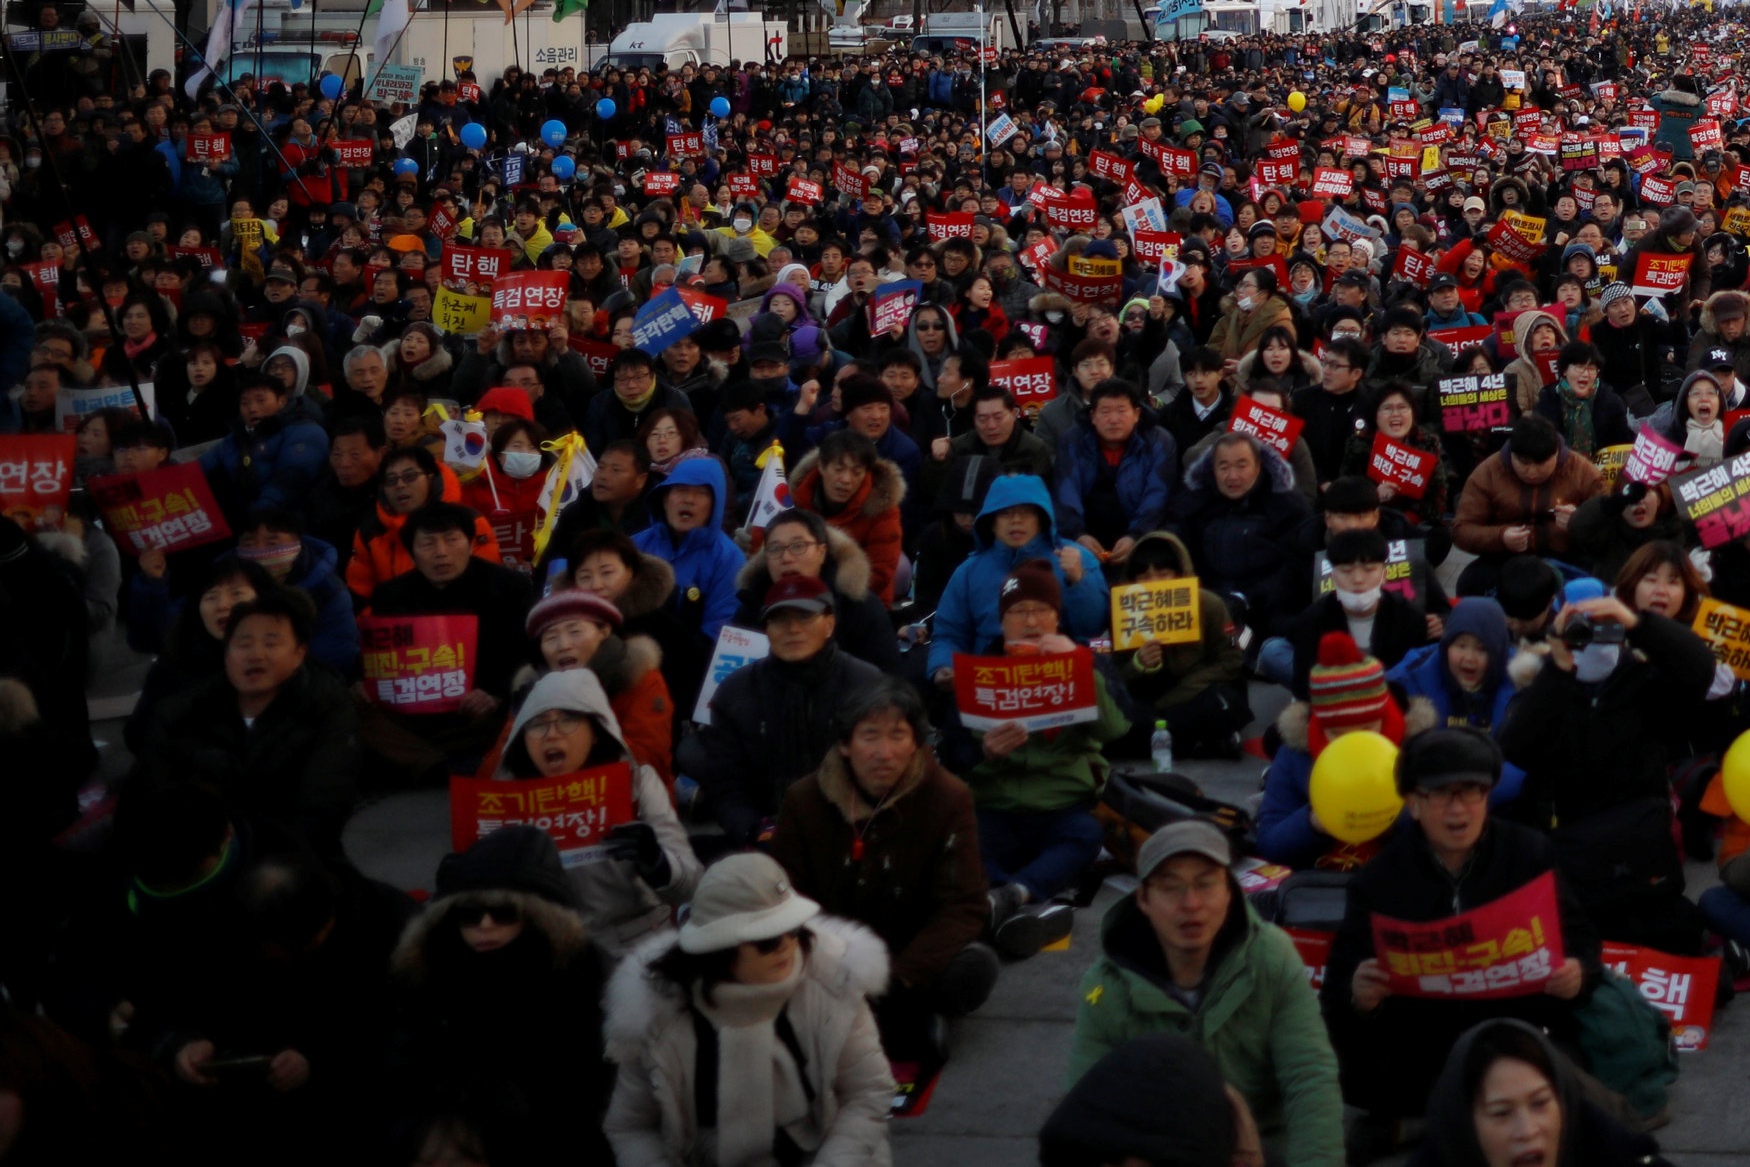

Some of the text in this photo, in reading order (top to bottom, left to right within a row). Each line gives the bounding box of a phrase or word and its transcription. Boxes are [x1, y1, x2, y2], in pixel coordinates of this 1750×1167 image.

[536, 46, 578, 64] 소음관리
[1394, 102, 1415, 116] 탄핵
[1711, 100, 1731, 112] 탄핵
[193, 136, 226, 155] 탄핵
[672, 136, 700, 152] 탄핵
[1690, 128, 1721, 143] 특검연장
[751, 159, 773, 173] 탄핵
[1095, 156, 1127, 179] 탄핵
[1161, 151, 1191, 173] 탄핵
[1262, 163, 1294, 182] 탄핵
[1388, 164, 1411, 177] 탄핵
[1047, 206, 1095, 224] 특검연장
[929, 222, 971, 239] 특검연장
[1135, 239, 1180, 258] 특검연장
[450, 253, 500, 280] 탄핵
[1072, 261, 1117, 276] 박근혜를
[491, 286, 565, 310] 특검연장
[1711, 349, 1728, 361] NY
[1439, 373, 1505, 394] 박근혜 4년
[1439, 389, 1507, 407] 너희들의 세상은
[1248, 405, 1286, 433] 박근혜
[1441, 403, 1510, 433] 끝났다
[1384, 443, 1420, 469] 박근혜
[1635, 435, 1677, 469] 박근혜
[1372, 454, 1424, 489] 퇴진·구속
[1679, 463, 1730, 503] 박근혜
[1687, 483, 1735, 519] 너희들의
[1118, 587, 1192, 613] 박근혜를
[1120, 612, 1193, 637] 구속하라
[363, 642, 465, 680] 퇴진·구속!
[973, 659, 1075, 687] 조기탄핵!
[376, 669, 467, 705] 특검연장
[974, 681, 1075, 711] 특검연장!
[476, 776, 607, 816] 조기탄핵!
[1417, 948, 1551, 995] 특검연장
